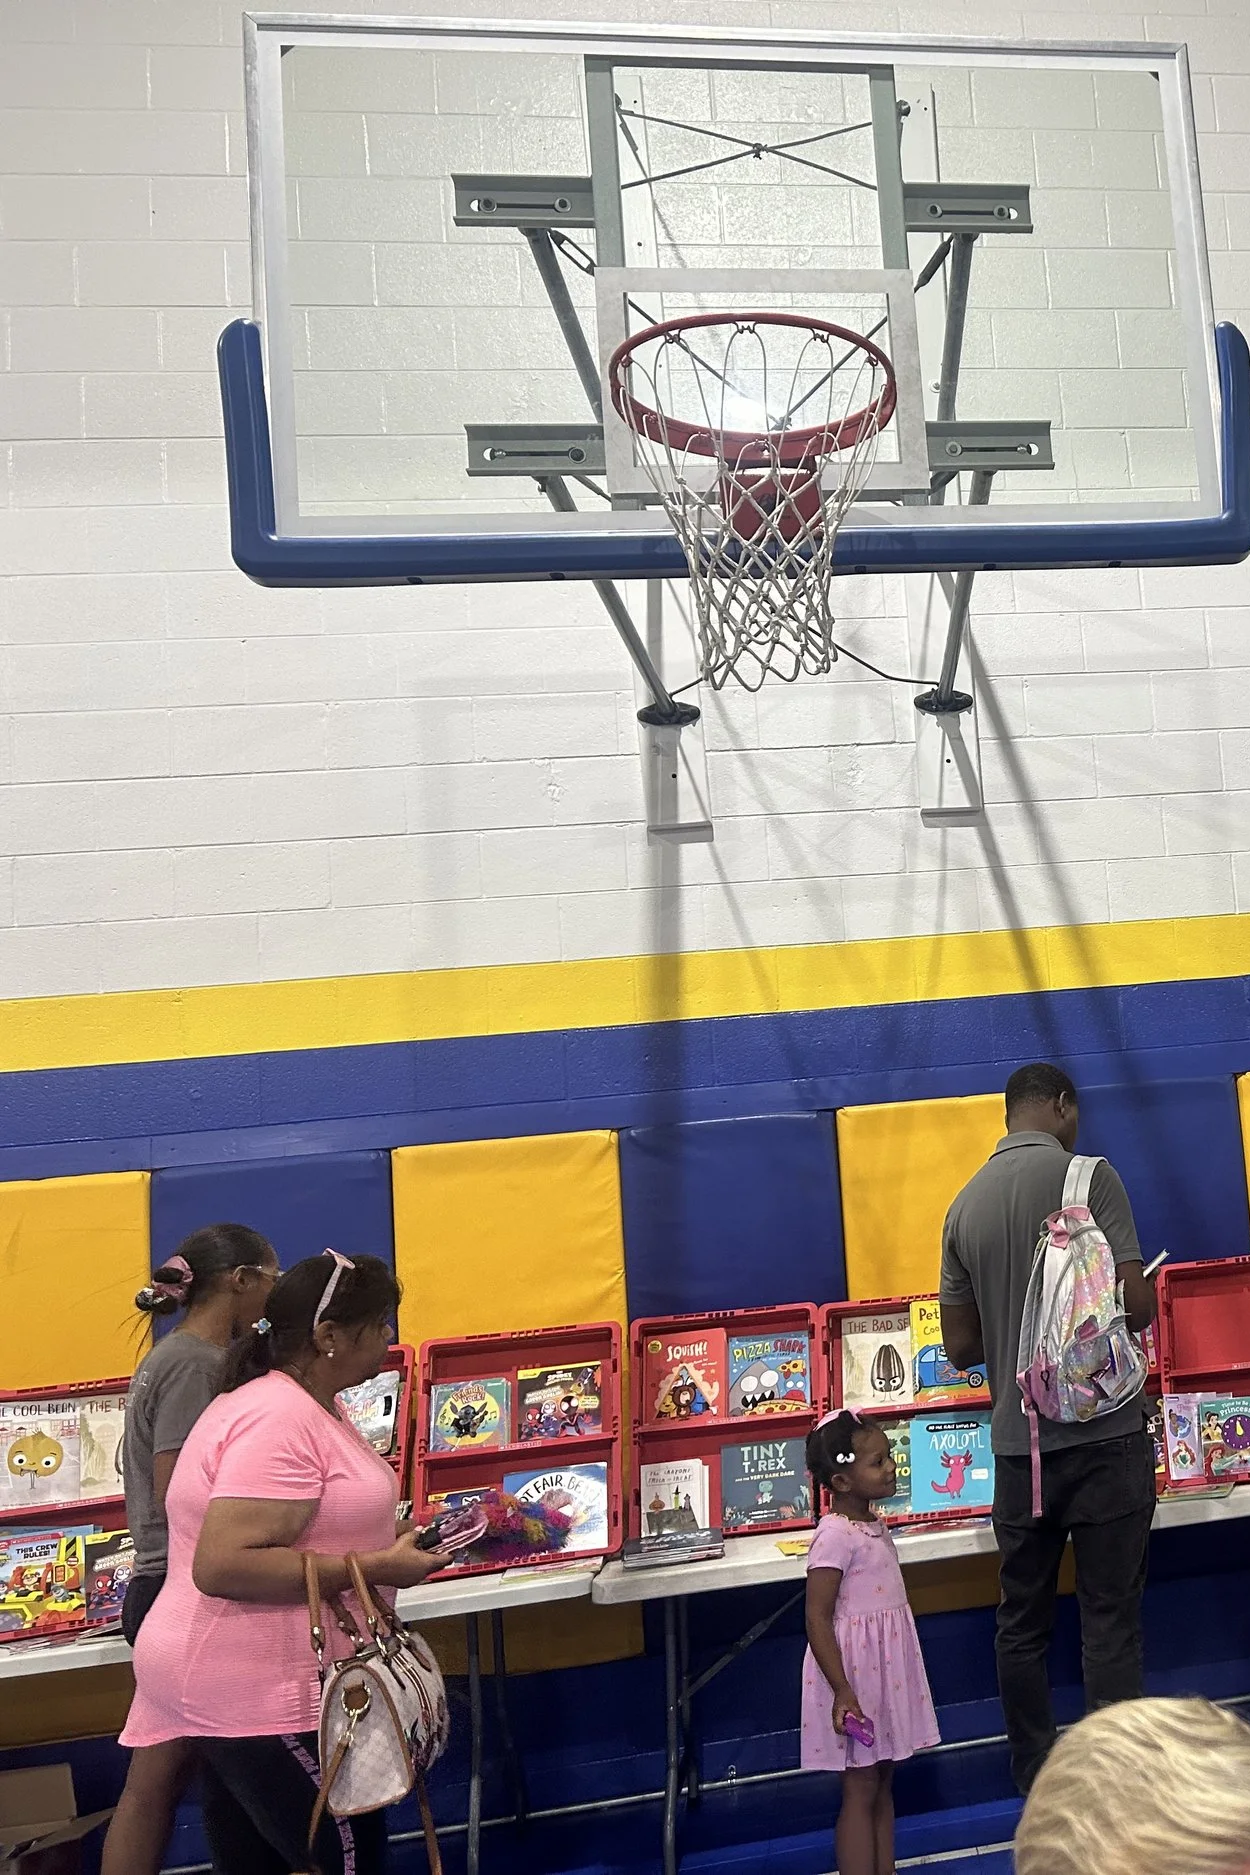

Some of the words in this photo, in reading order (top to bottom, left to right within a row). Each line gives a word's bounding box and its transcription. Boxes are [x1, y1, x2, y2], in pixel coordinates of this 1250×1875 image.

[847, 1321, 867, 1333] THE
[872, 1318, 893, 1331] BAD
[733, 1342, 771, 1362] PIZZA
[452, 1384, 485, 1402] Friends
[461, 1392, 486, 1404] Rock!
[13, 1404, 42, 1417] COOL
[47, 1402, 76, 1414] BEAN
[87, 1400, 112, 1414] THE
[929, 1430, 985, 1451] AXOLOTL
[740, 1442, 787, 1462] TINY
[742, 1462, 755, 1474] T.
[758, 1457, 786, 1472] REX
[16, 1546, 34, 1554] THIS
[35, 1543, 58, 1552] CREW
[23, 1550, 51, 1560] RULES!
